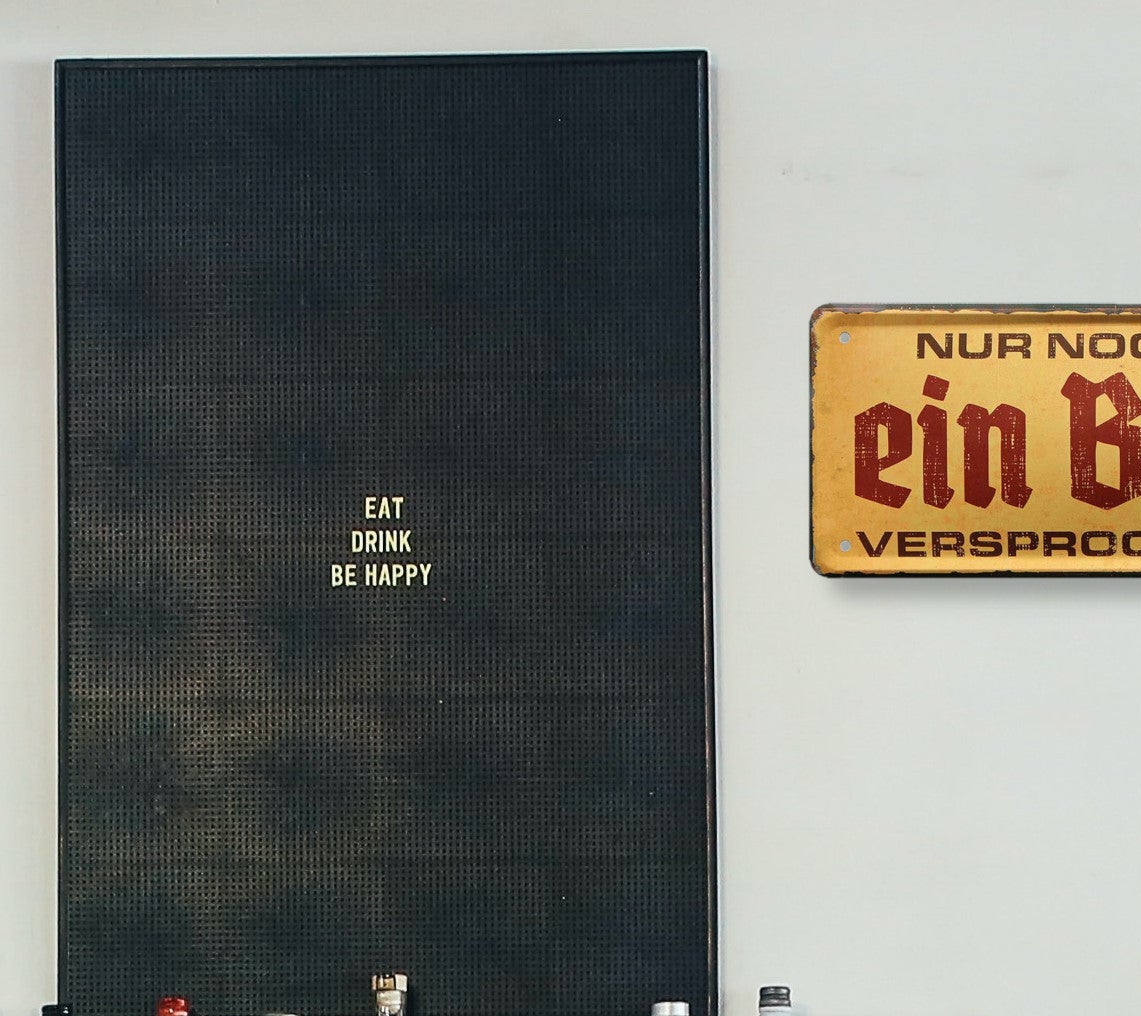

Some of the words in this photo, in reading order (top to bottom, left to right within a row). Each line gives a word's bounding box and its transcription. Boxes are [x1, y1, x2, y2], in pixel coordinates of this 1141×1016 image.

[917, 333, 1031, 359] NUR
[854, 374, 1033, 510] ein
[365, 496, 404, 519] EAT
[351, 529, 411, 553] DRINK
[331, 564, 357, 587] BE
[365, 563, 431, 586] HAPPY
